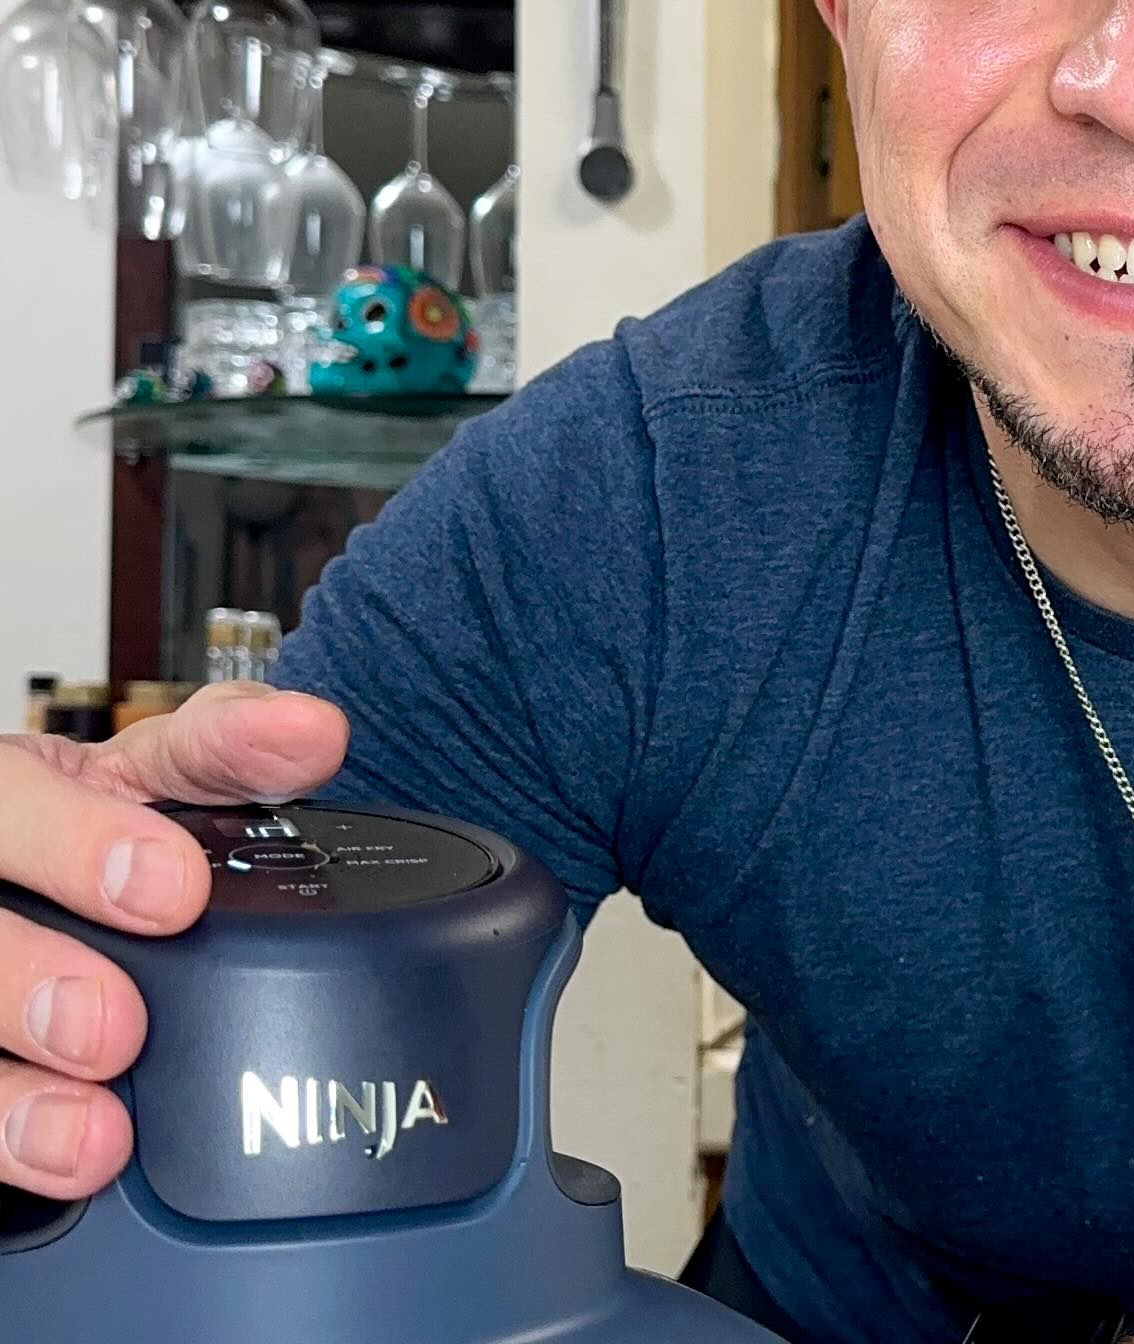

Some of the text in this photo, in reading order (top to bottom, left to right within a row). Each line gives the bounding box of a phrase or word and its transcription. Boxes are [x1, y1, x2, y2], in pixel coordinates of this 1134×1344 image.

[336, 845, 362, 853] AIR
[253, 852, 306, 860] MODE
[384, 857, 428, 866] CRISP
[277, 883, 328, 891] START
[241, 1070, 449, 1160] NINJA
